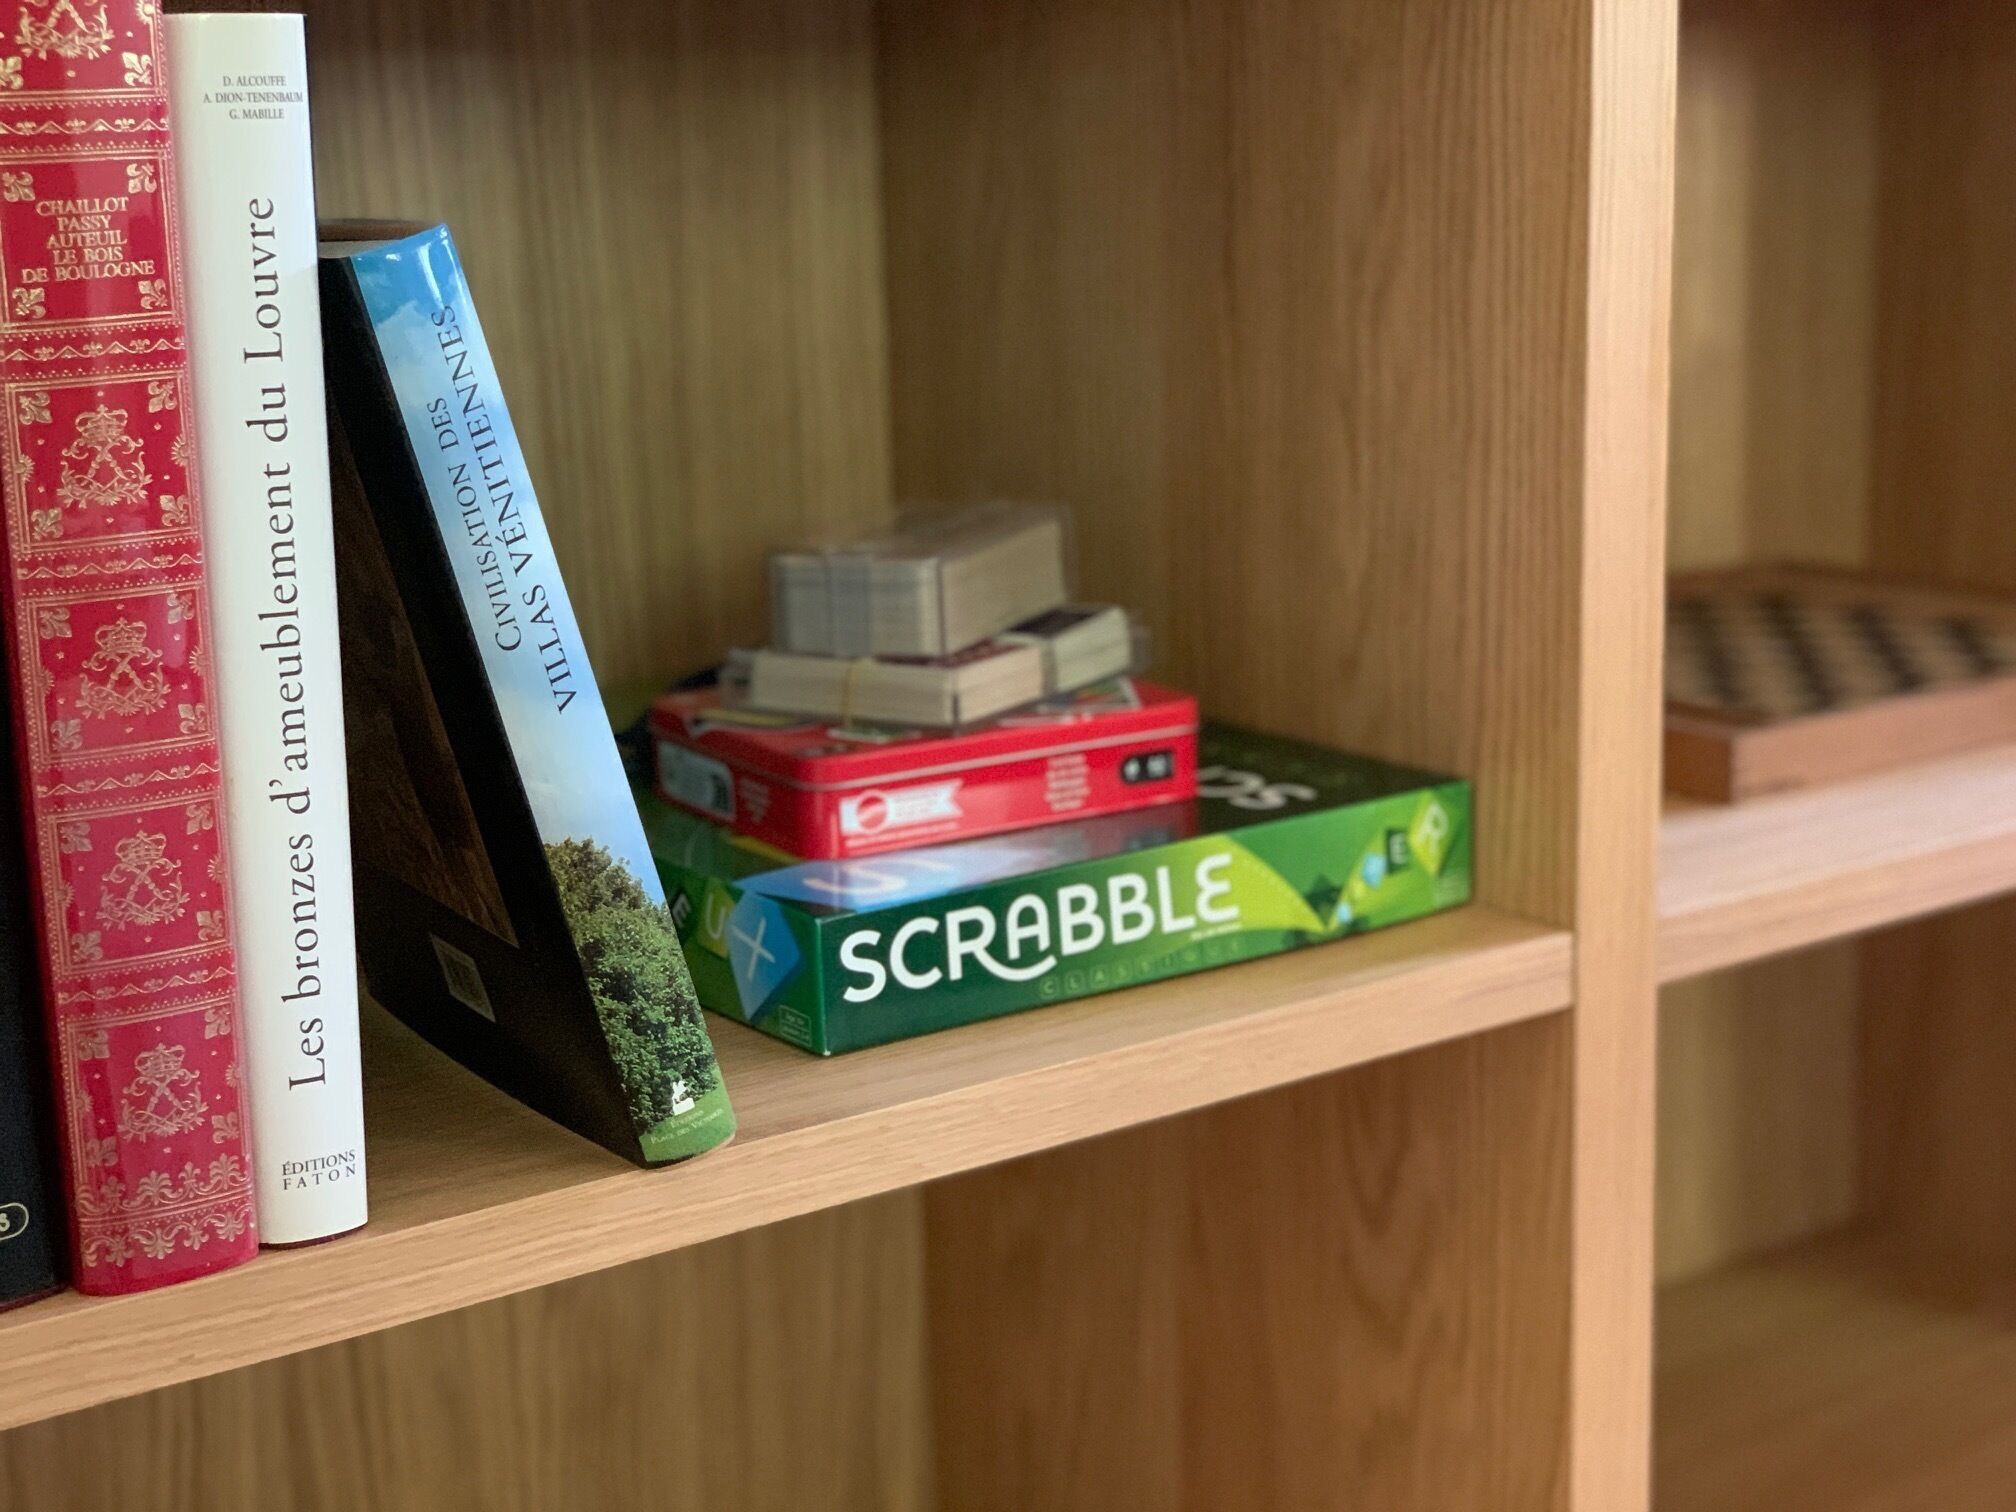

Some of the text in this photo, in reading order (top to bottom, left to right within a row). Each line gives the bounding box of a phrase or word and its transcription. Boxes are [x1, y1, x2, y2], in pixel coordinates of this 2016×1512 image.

[222, 75, 287, 87] D. ALCOUFFE
[203, 91, 304, 104] A. DION-TENENBAUM
[229, 108, 285, 120] G. MABILLE
[35, 196, 129, 216] CHAILLOT
[57, 214, 111, 232] PASSY
[46, 230, 128, 249] AUTEUIL
[52, 246, 124, 265] LE BOIS
[21, 260, 156, 284] DE BOULOGNE
[243, 197, 284, 363] Louvre
[246, 382, 289, 443] du
[426, 397, 460, 453] DES
[431, 304, 577, 715] VILLAS VÉNITIENNES
[281, 832, 323, 1003] bronzes
[839, 852, 1240, 1003] SCRABBLE
[288, 1017, 327, 1091] Les
[282, 1149, 356, 1176] ÉDITIONS
[283, 1163, 356, 1190] FATON
